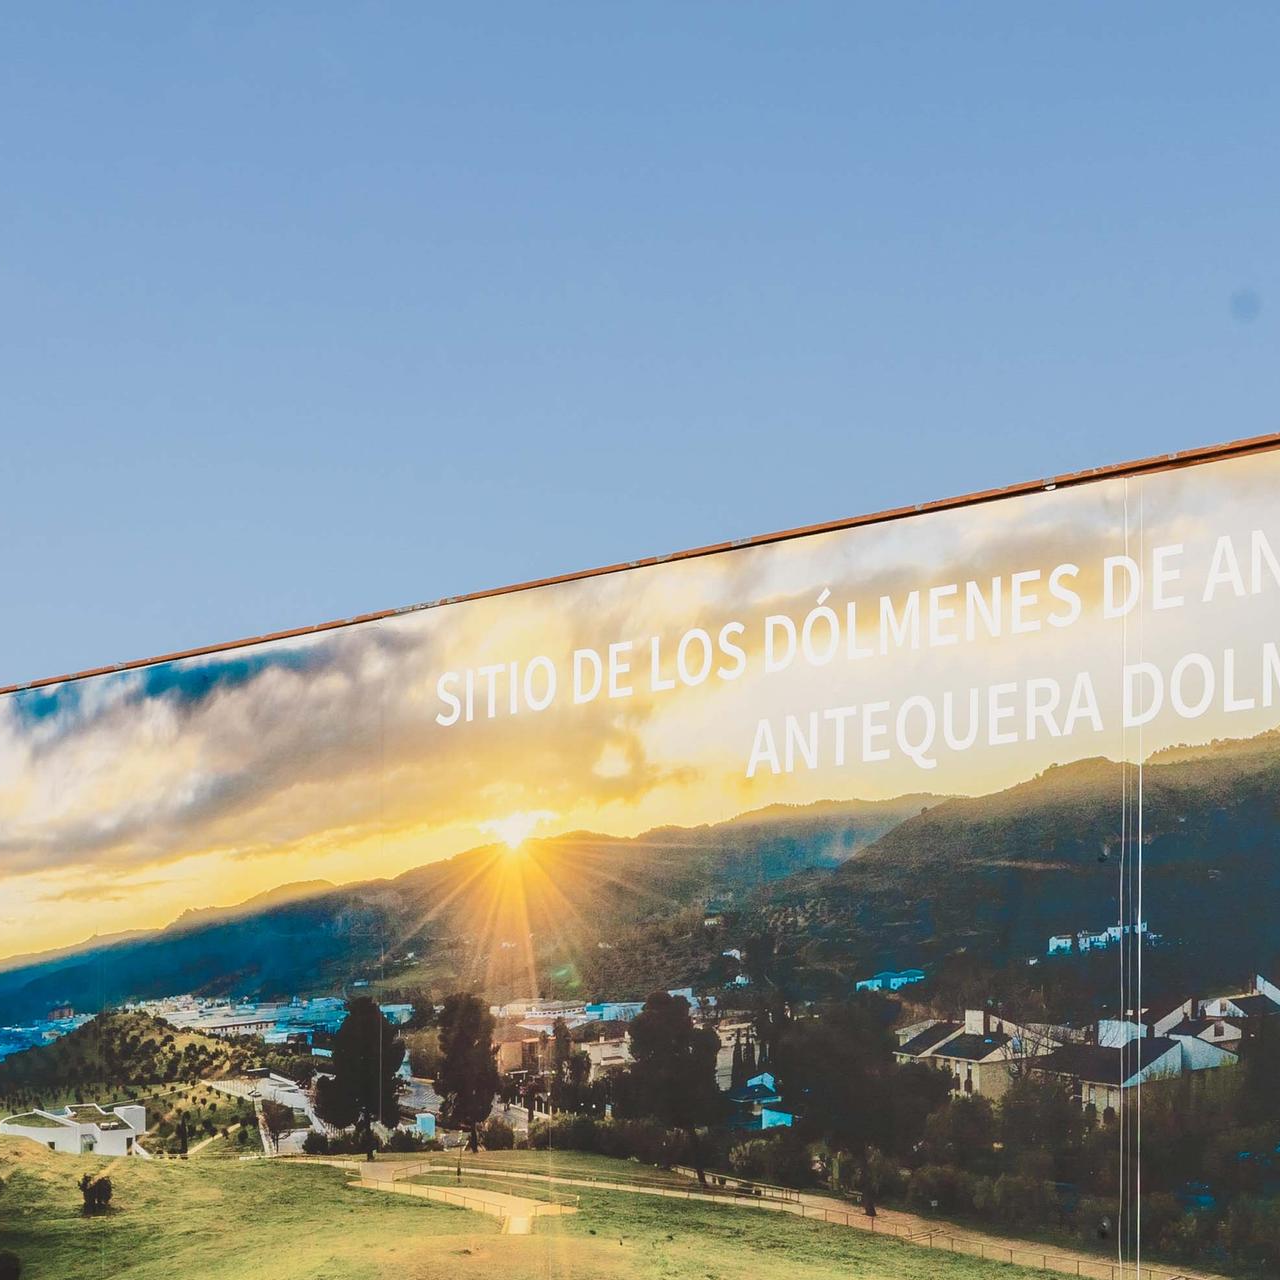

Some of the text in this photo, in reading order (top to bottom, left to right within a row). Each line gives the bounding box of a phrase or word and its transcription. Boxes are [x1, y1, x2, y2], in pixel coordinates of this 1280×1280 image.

[435, 655, 558, 727] SITIO
[573, 641, 633, 705] DE
[650, 621, 747, 692] LOS
[764, 563, 1082, 673] DÓLMENES
[1103, 543, 1186, 620] DE
[746, 670, 1103, 778] ANTEQUERA
